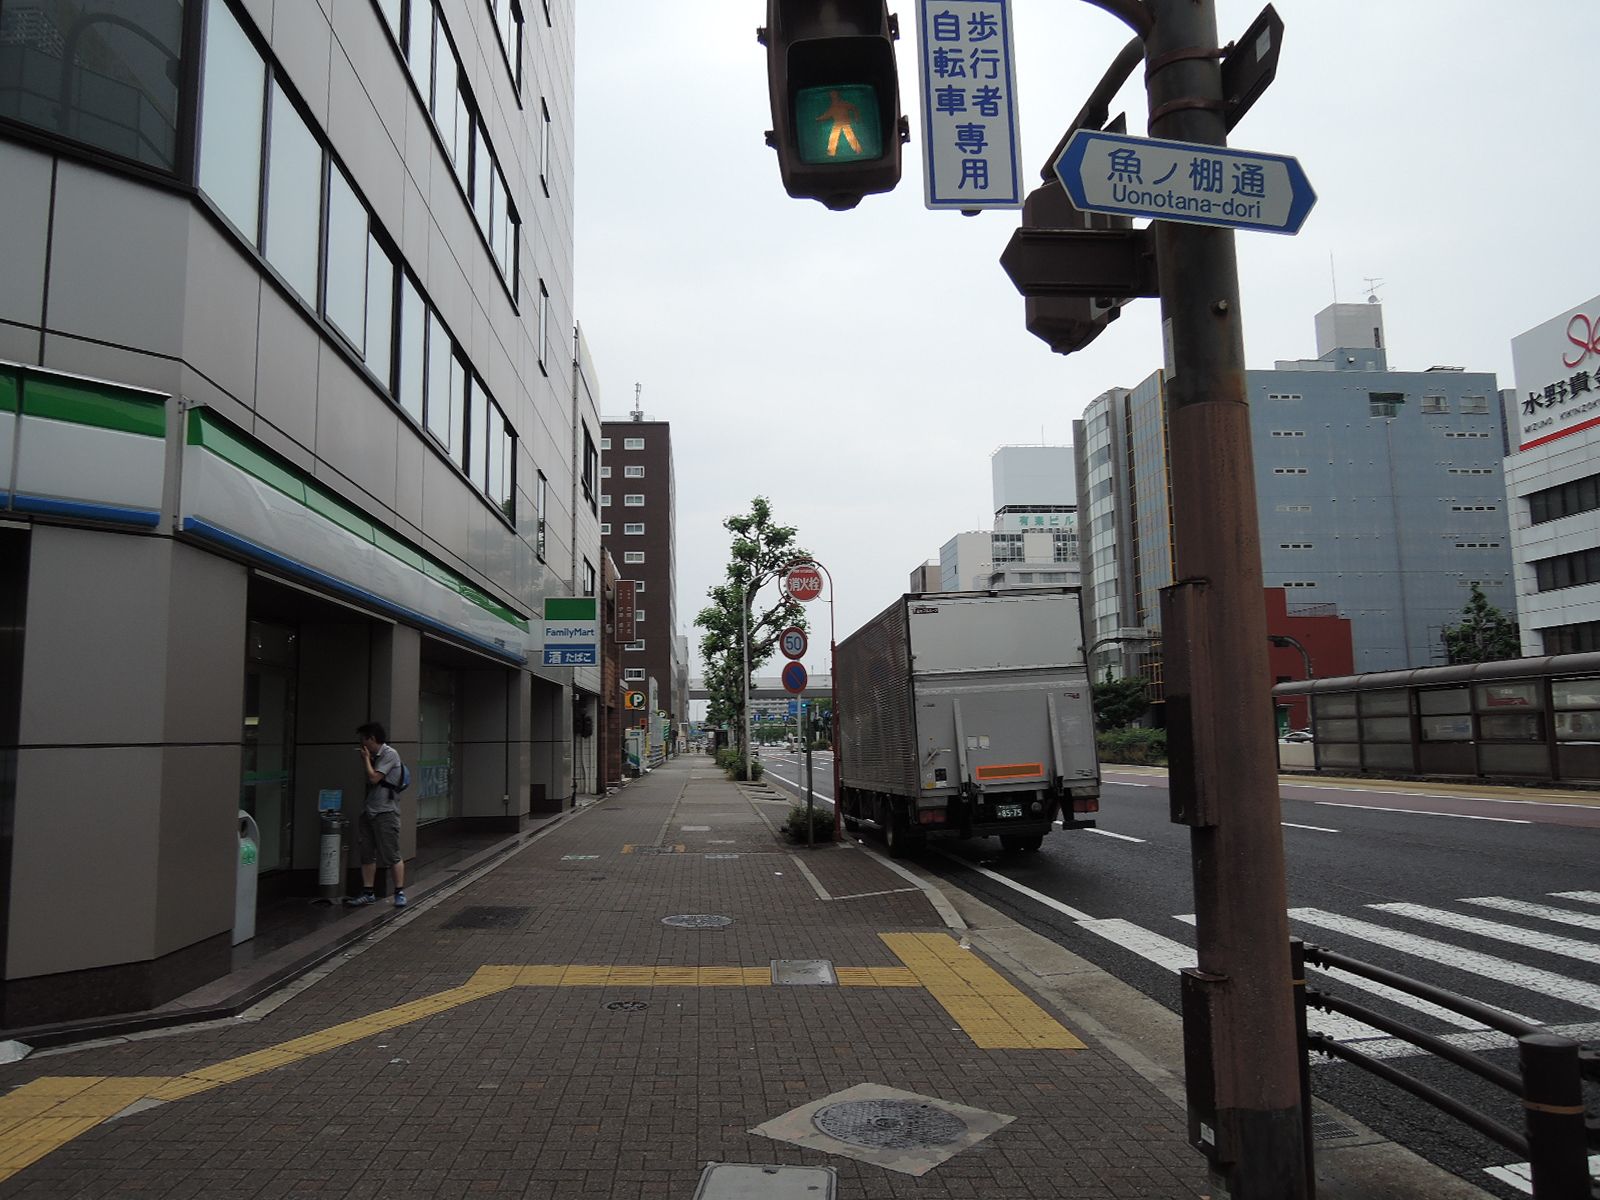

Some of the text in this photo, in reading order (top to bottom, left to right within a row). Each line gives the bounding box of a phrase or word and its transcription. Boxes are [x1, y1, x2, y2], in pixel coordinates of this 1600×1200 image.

[932, 10, 967, 117] 自転車
[966, 11, 1003, 117] 歩行者
[954, 122, 988, 190] 専用
[1106, 147, 1266, 199] 魚ノ棚通
[1112, 182, 1262, 219] Uonotana-dori
[789, 577, 820, 592] 消火栓
[545, 627, 595, 639] FamilyMart
[785, 635, 803, 651] 50
[548, 650, 592, 665] 酒 たばこ
[633, 694, 644, 707] P
